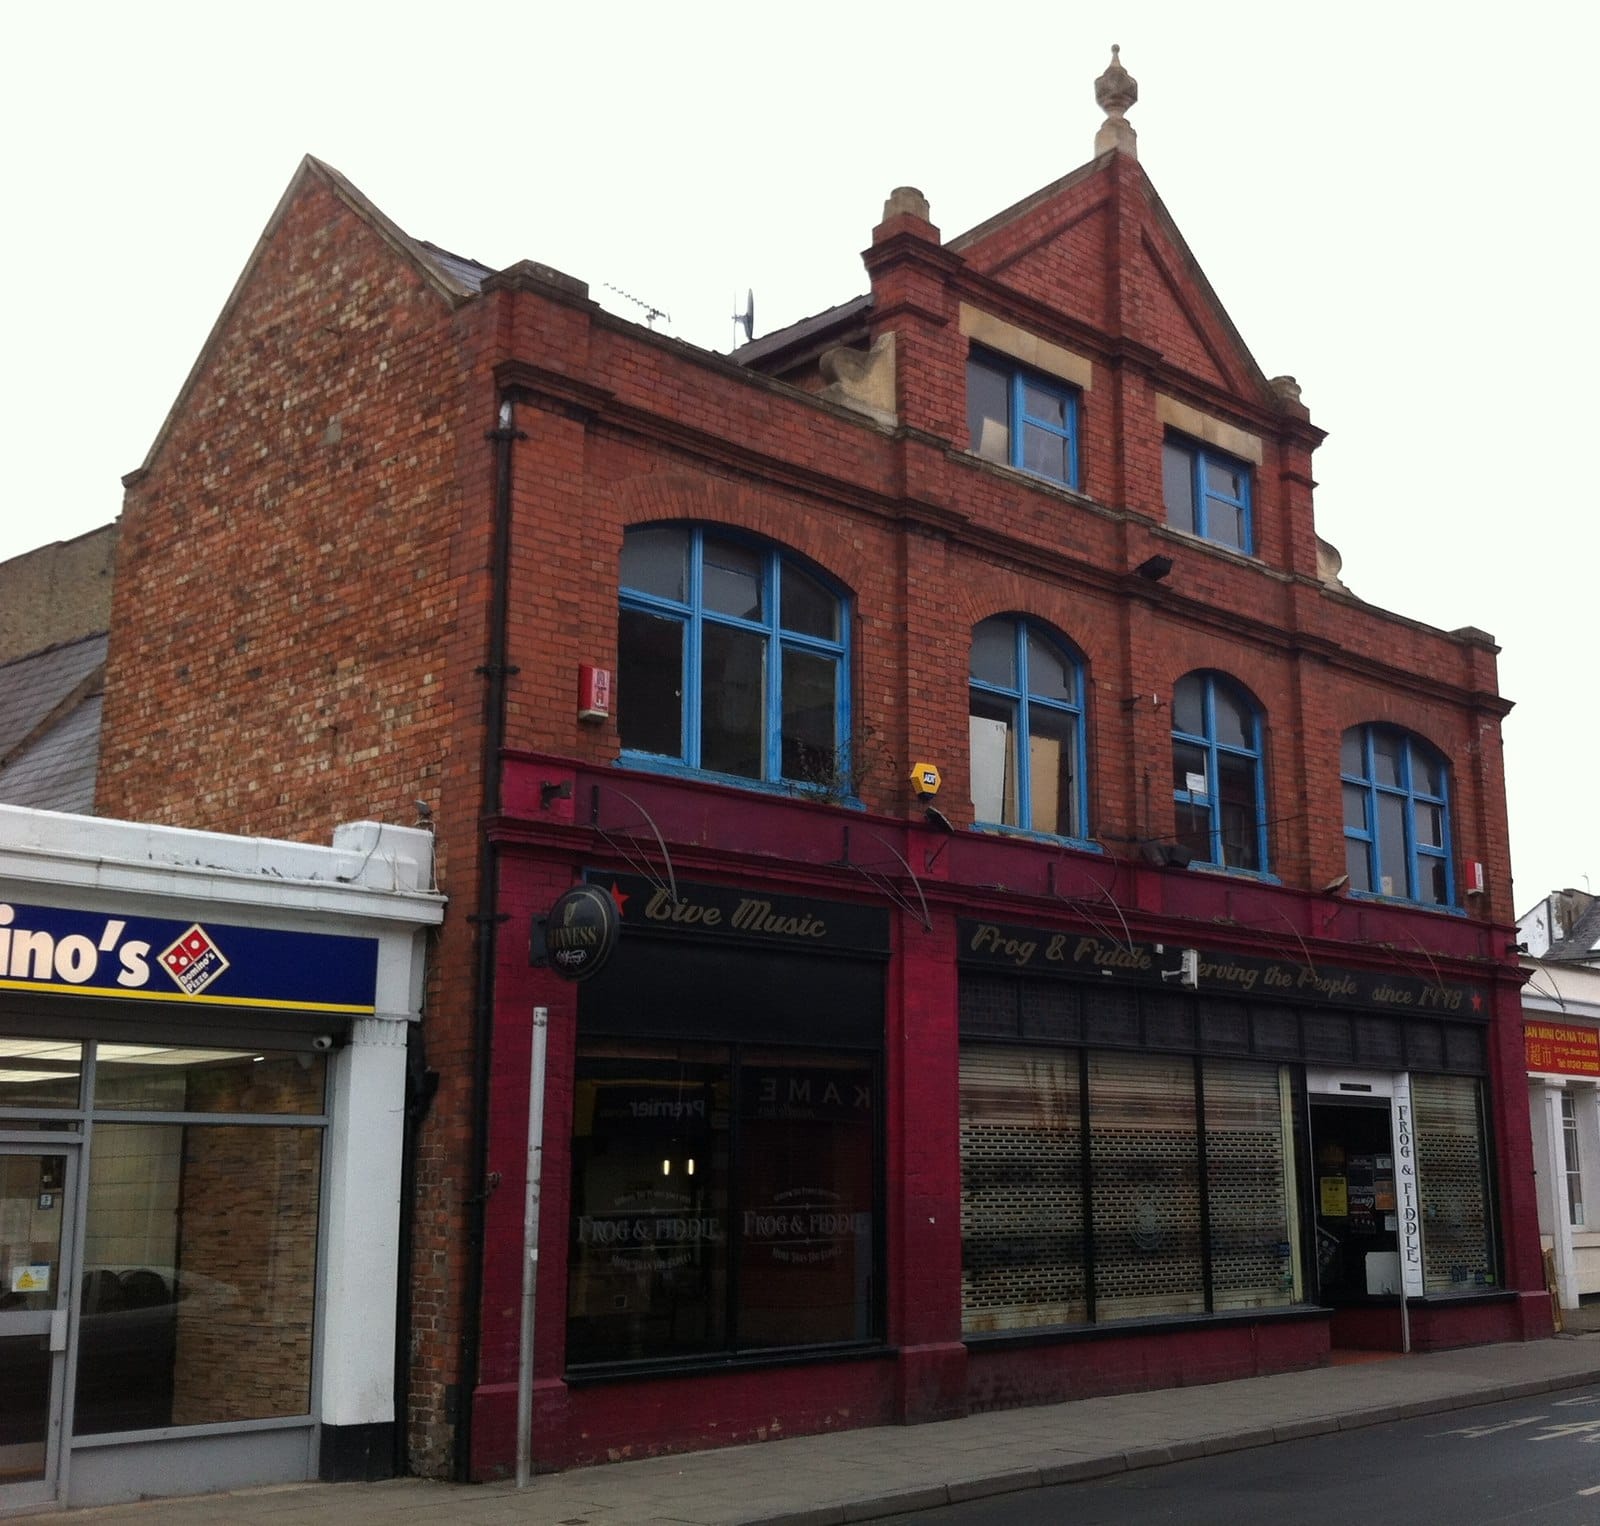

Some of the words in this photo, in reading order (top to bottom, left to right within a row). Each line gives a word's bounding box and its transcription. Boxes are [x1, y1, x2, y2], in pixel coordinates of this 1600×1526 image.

[644, 887, 723, 926] Live
[730, 898, 827, 938] Music
[179, 952, 216, 985] Domino's
[969, 924, 1038, 967] Frog
[1045, 933, 1067, 961] &
[1073, 937, 1152, 970] Fiddle
[1197, 954, 1259, 990] erving
[1263, 966, 1292, 987] the
[1296, 967, 1358, 998] People
[1371, 983, 1414, 1005] since
[186, 971, 209, 992] Pizza
[1555, 1029, 1577, 1042] CHINA
[1577, 1031, 1597, 1045] TOWN
[1525, 1042, 1552, 1066] 超市
[1398, 1105, 1412, 1159] FROG
[1401, 1164, 1414, 1176] &
[632, 1219, 649, 1241] &
[790, 1215, 804, 1234] &
[1403, 1183, 1419, 1264] FIDDLE
